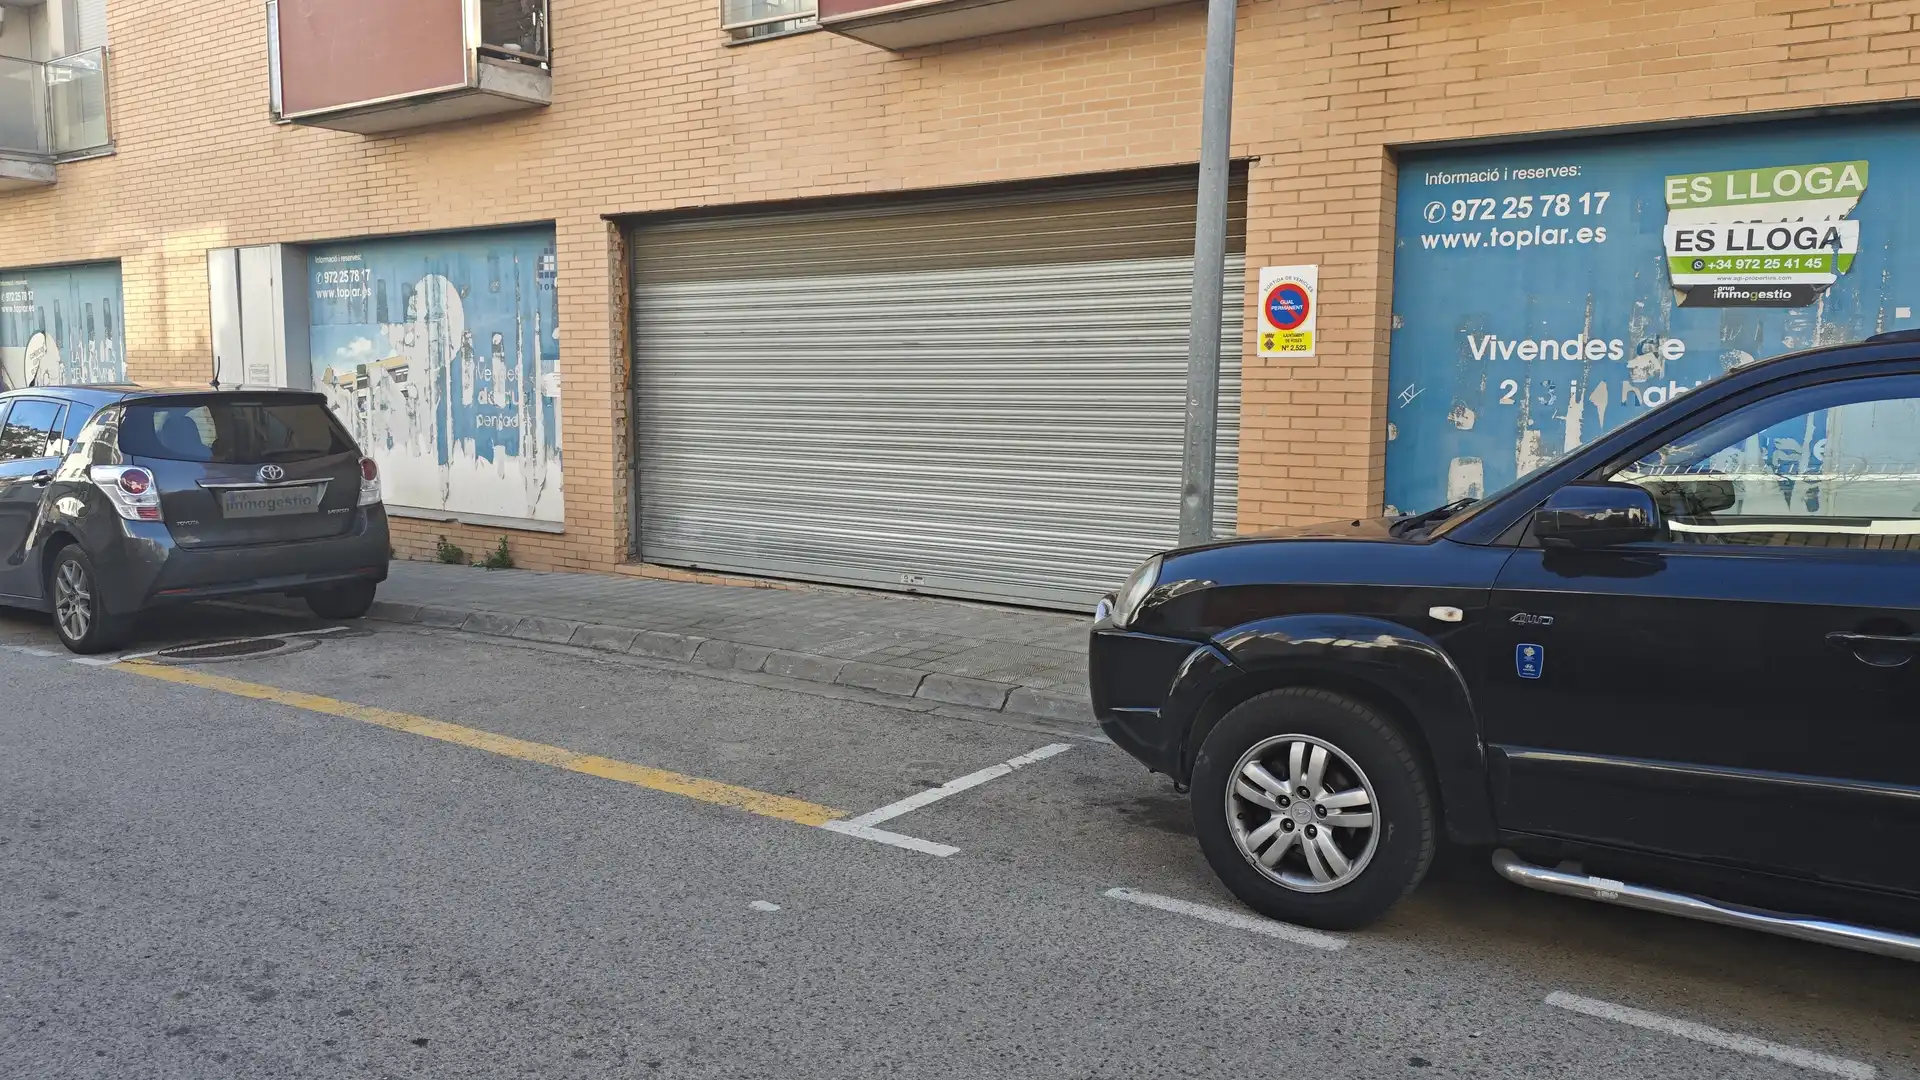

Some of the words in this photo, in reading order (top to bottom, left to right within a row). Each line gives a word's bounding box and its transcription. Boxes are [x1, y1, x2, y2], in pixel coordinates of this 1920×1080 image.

[1425, 168, 1500, 185] Informació
[1512, 164, 1582, 180] reserves:
[1666, 176, 1713, 205] ES
[1726, 164, 1866, 201] LLOGA
[1451, 198, 1496, 222] 972
[1502, 196, 1533, 219] 25
[1540, 194, 1571, 217] 78
[1579, 192, 1611, 215] 17
[1421, 225, 1607, 250] www.toplar.es
[1674, 229, 1715, 252] ES
[1726, 226, 1843, 251] LLOGA
[323, 270, 338, 283] 972
[339, 270, 349, 283] 25
[350, 269, 360, 282] 78
[361, 268, 371, 281] 17
[1707, 259, 1732, 270] +34
[1735, 259, 1760, 270] 972
[1764, 258, 1780, 269] 25
[1784, 258, 1800, 269] 41
[1804, 257, 1822, 268] 45
[1713, 288, 1792, 300] immogestio
[1467, 334, 1624, 361] Vivendes
